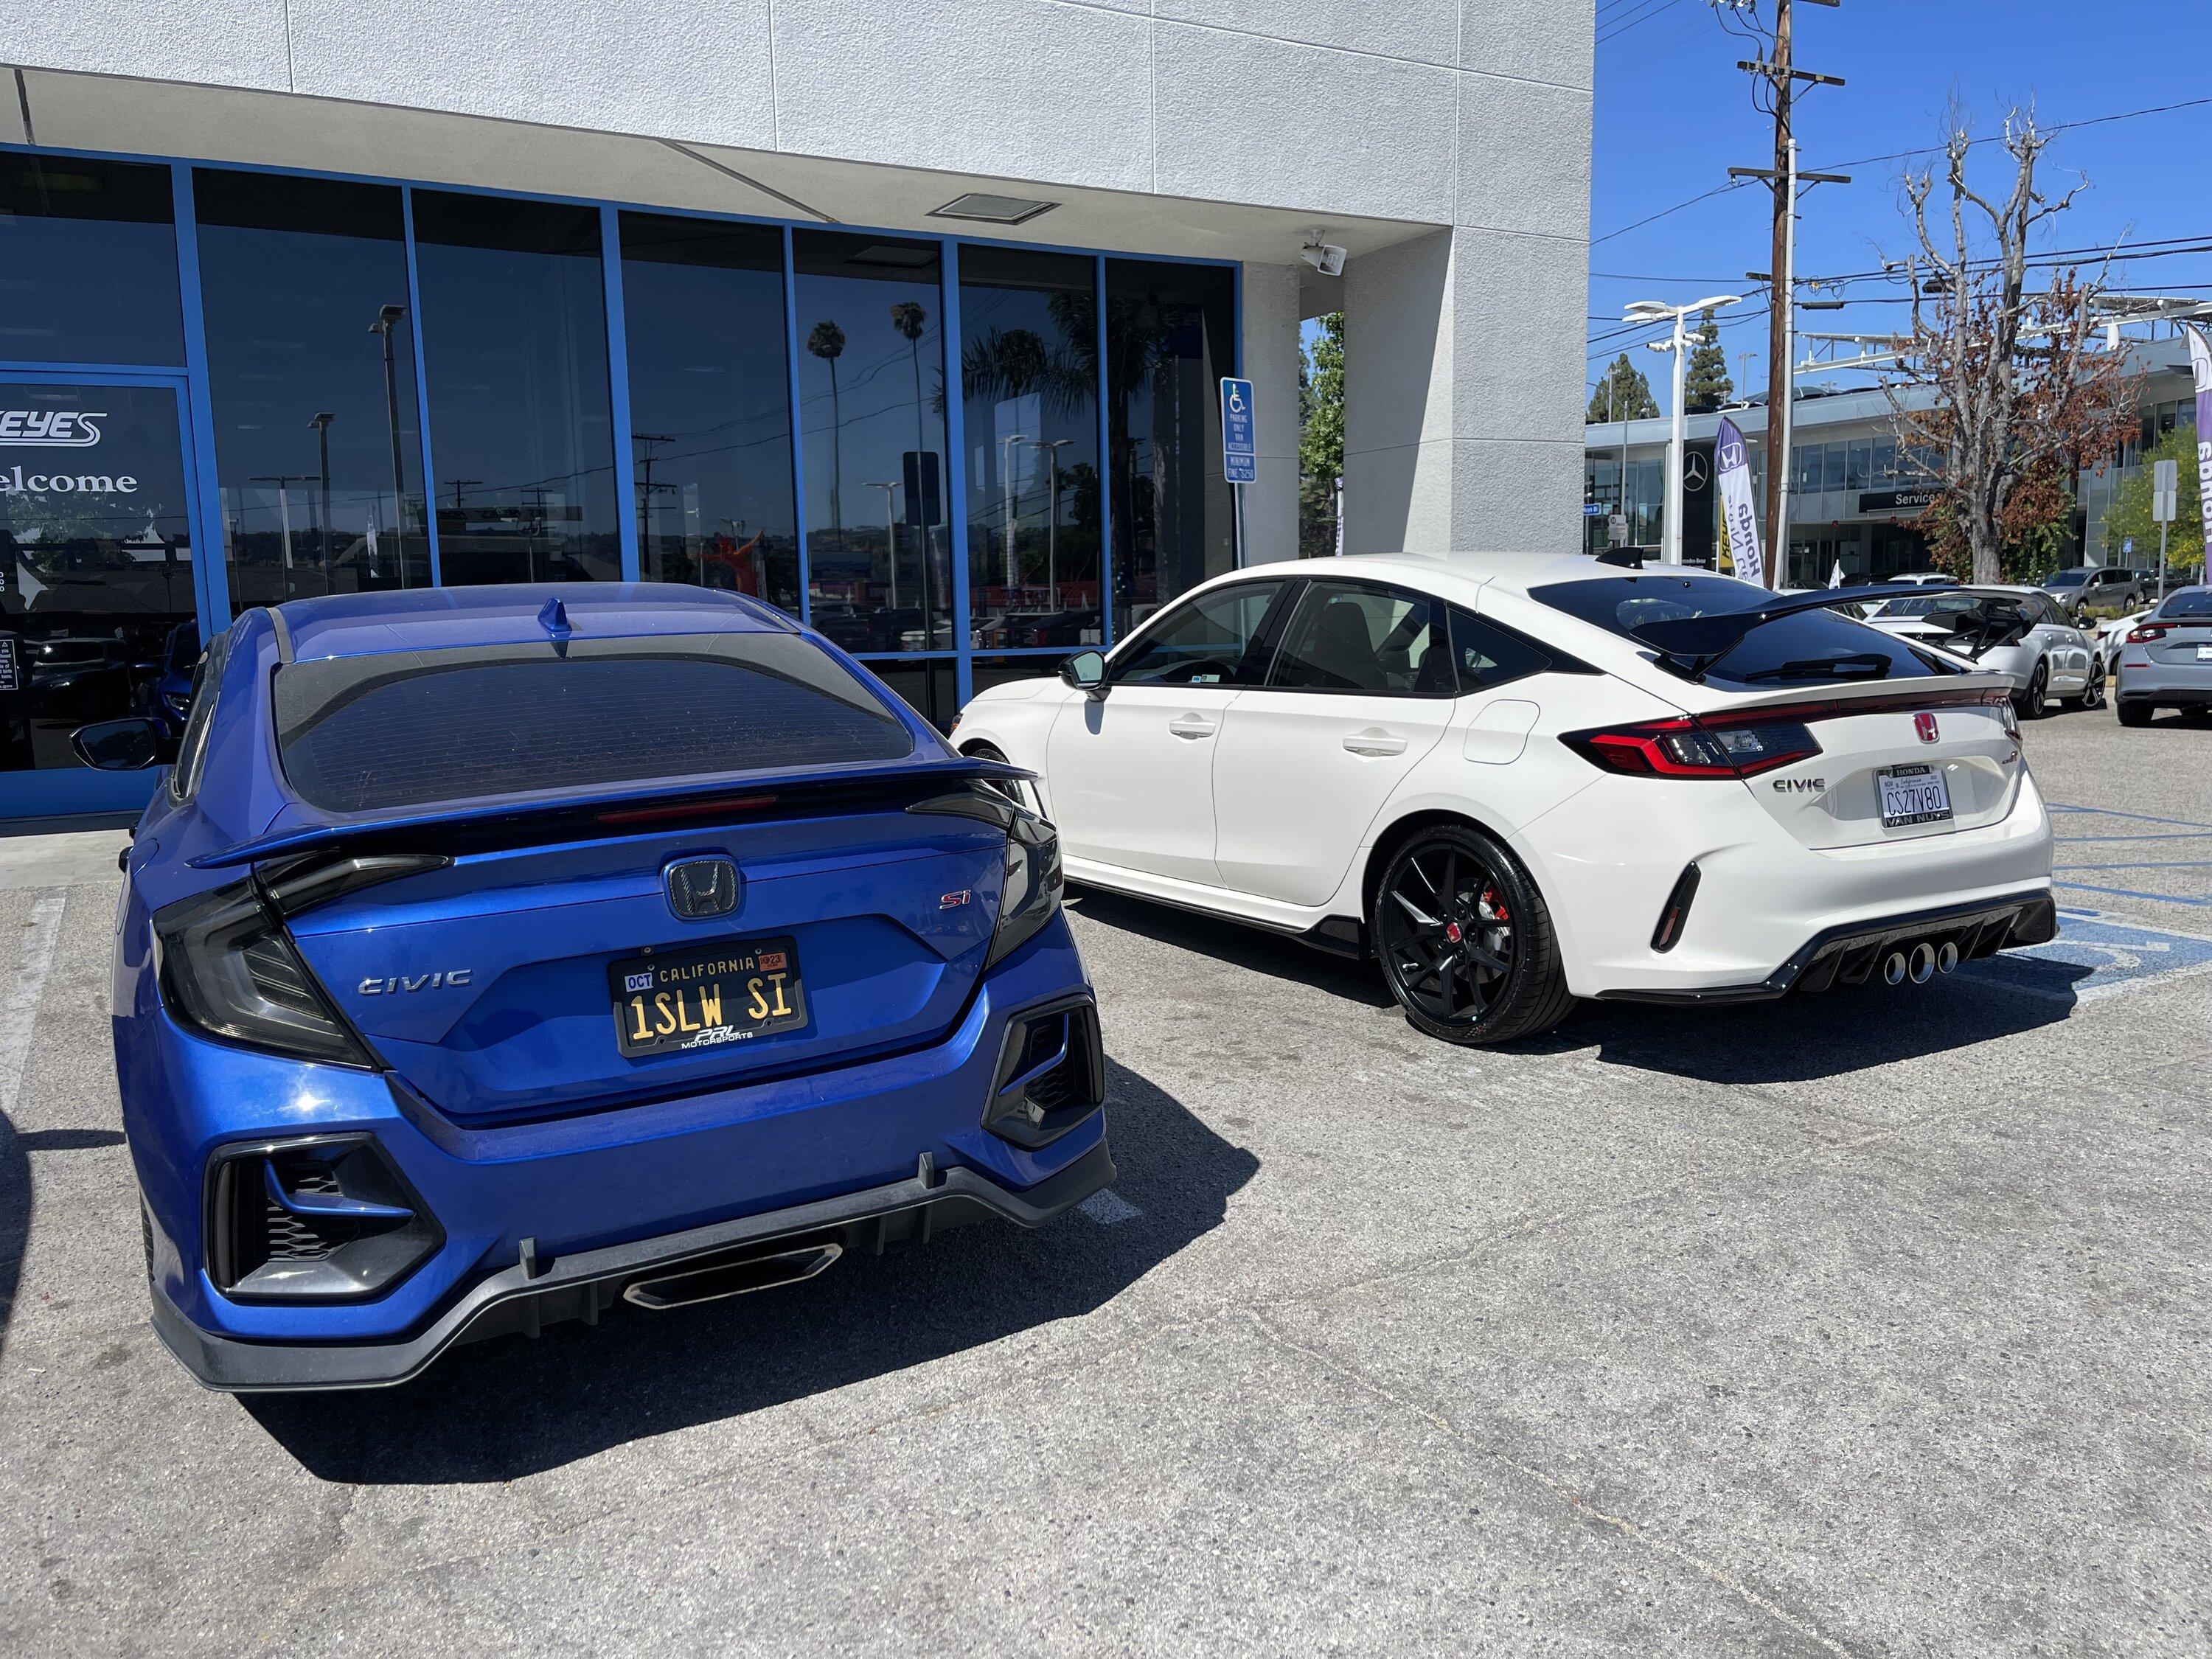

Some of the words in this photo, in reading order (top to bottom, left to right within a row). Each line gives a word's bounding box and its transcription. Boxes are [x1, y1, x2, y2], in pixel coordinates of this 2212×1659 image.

[1230, 413, 1248, 423] PARKING
[0, 411, 108, 447] EYES
[1233, 423, 1245, 432] ONLY
[1228, 442, 1252, 451] ACCESSIBLE
[1230, 456, 1251, 467] MINIMUM
[0, 465, 138, 493] elcome
[1228, 467, 1239, 478] FINE
[1895, 493, 1935, 505] Service
[1896, 766, 1926, 776] HONDA
[1773, 779, 1825, 790] CIVIC
[1888, 816, 1913, 827] VAN
[1917, 812, 1950, 823] NUYS
[939, 889, 971, 909] Si
[660, 957, 754, 983] CALIFORNIA
[358, 969, 471, 995] CIVIC
[628, 975, 651, 989] OCT
[631, 984, 723, 1040] 1SLW
[747, 973, 792, 1020] SI
[695, 1024, 740, 1042] PRL
[681, 1032, 754, 1049] MOTORSPORTS
